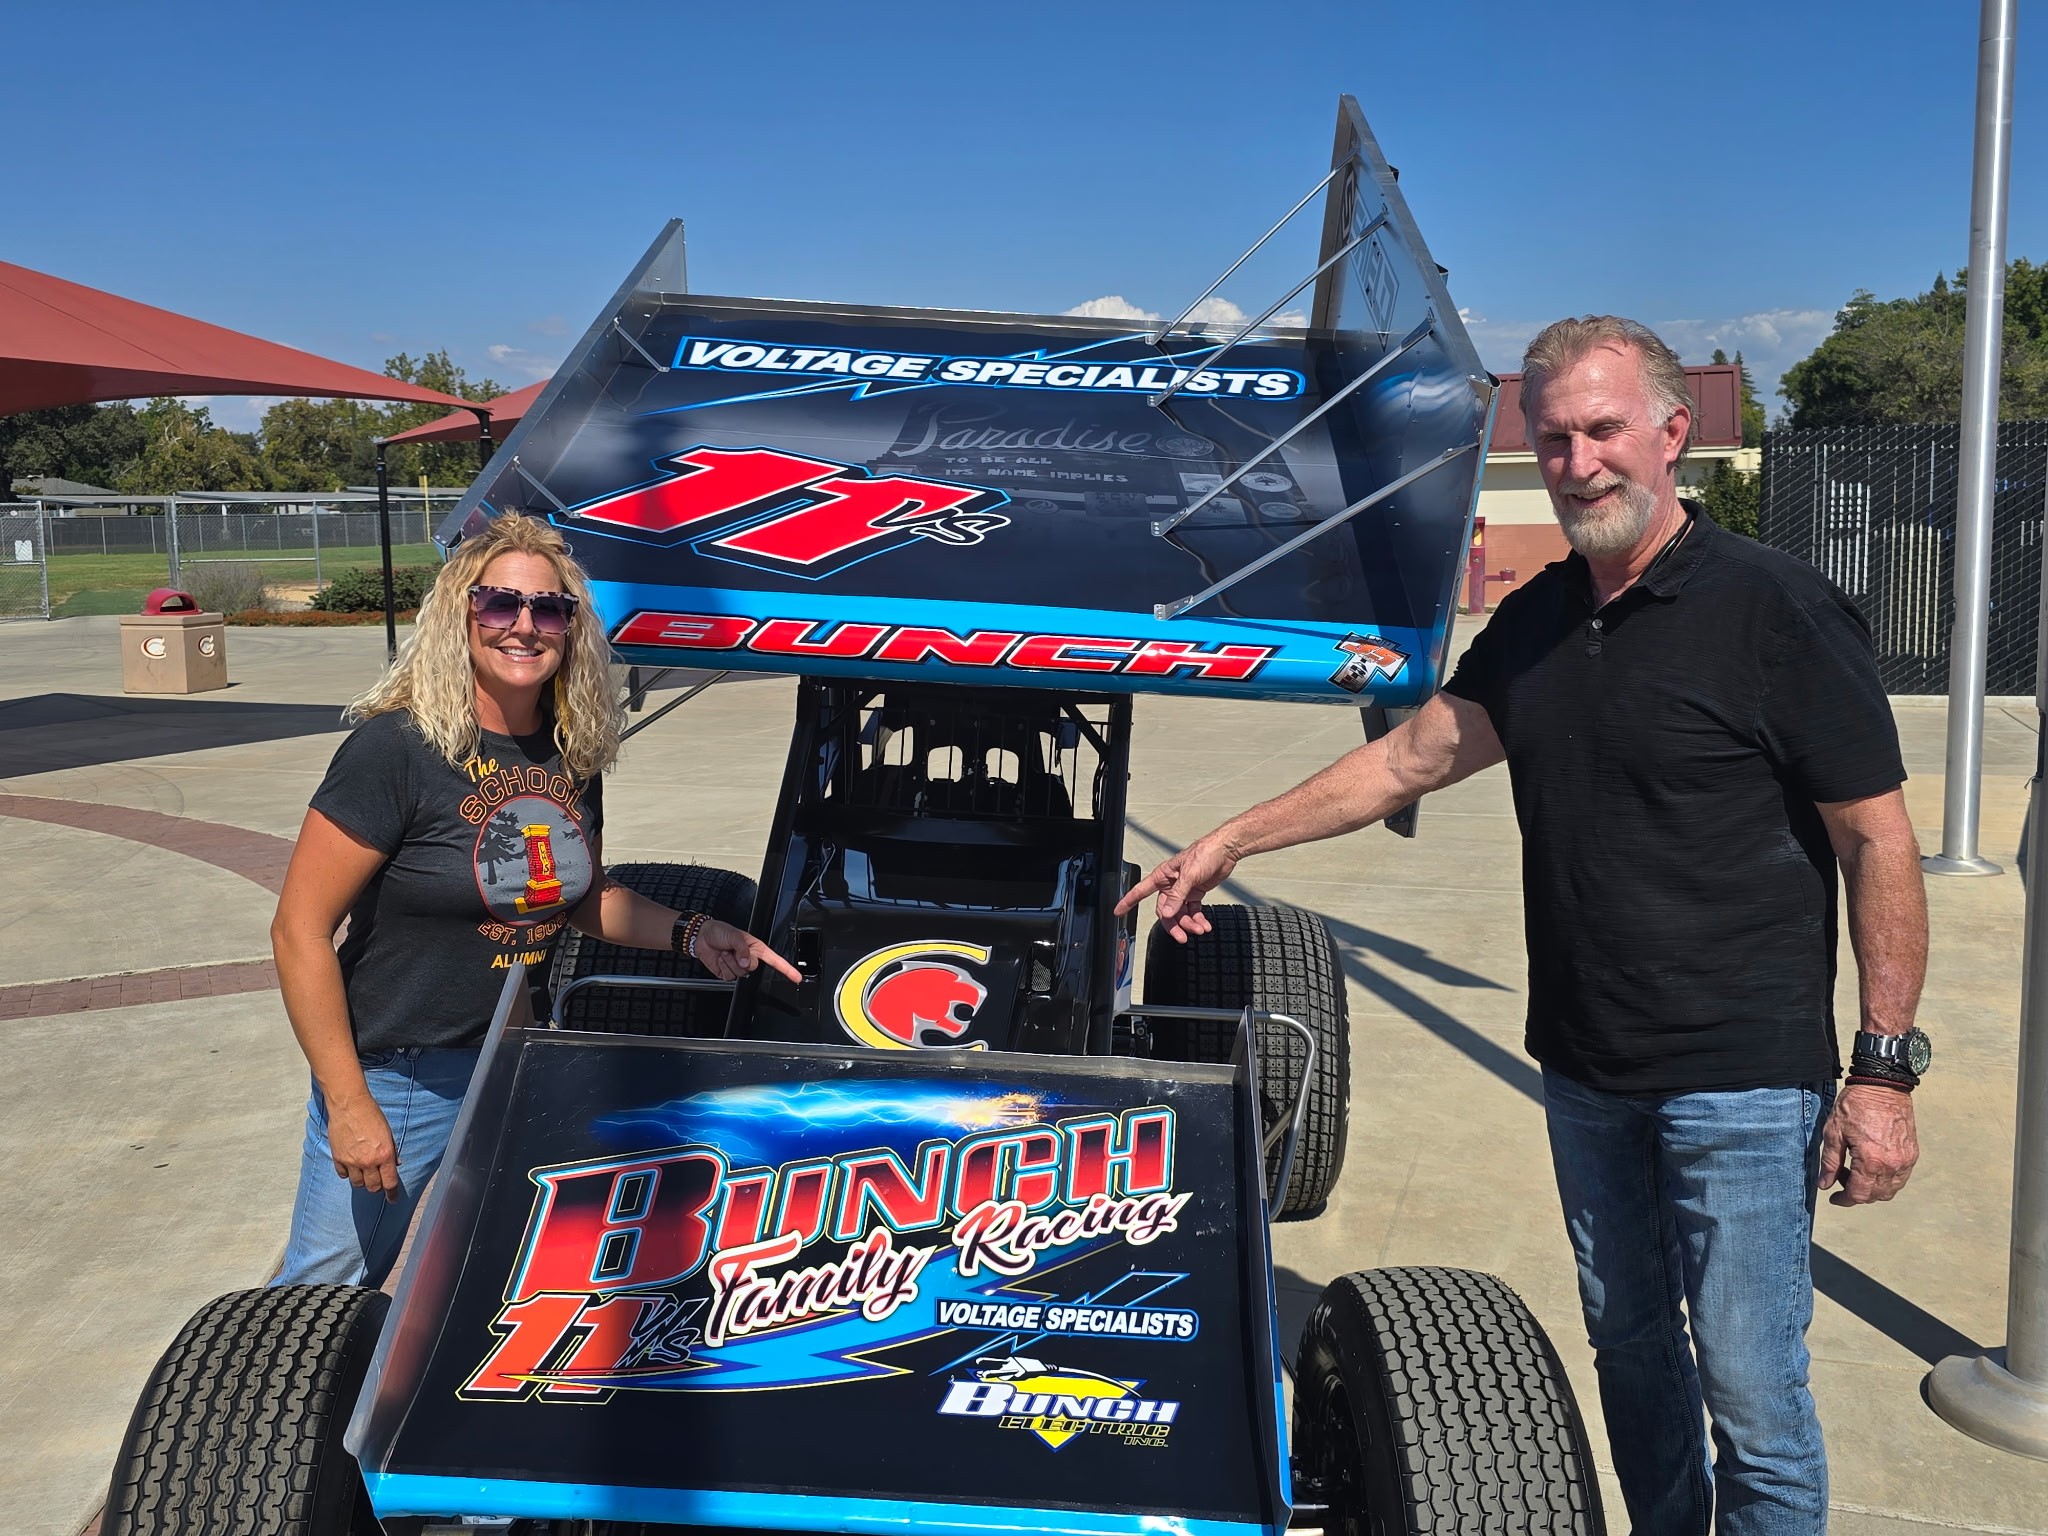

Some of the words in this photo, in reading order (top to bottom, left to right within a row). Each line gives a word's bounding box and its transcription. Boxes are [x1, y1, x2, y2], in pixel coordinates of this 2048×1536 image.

[688, 341, 931, 378] VOLTAGE
[940, 357, 1298, 396] SPECIALISTS
[896, 402, 1152, 457] Paradise
[944, 456, 969, 465] TO
[981, 456, 1007, 465] BE
[1015, 456, 1052, 465] ALL
[944, 468, 974, 477] ITS
[987, 468, 1038, 478] NAME
[1050, 471, 1129, 483] IMPLIES
[612, 611, 1277, 681] BUNCH
[463, 755, 499, 782] The
[459, 765, 583, 825] SCHOOL
[477, 919, 517, 946] EST.
[490, 948, 548, 969] ALUMNI
[504, 1107, 1177, 1302] BUNCH
[704, 1230, 936, 1348] Family
[951, 1191, 1193, 1276] Racing
[938, 1301, 1044, 1330] VOLTAGE
[1045, 1307, 1195, 1338] SPECIALISTS
[936, 1379, 1180, 1424] BUNCH
[998, 1415, 1171, 1438] ELECTRIC
[1122, 1435, 1169, 1448] INC.
